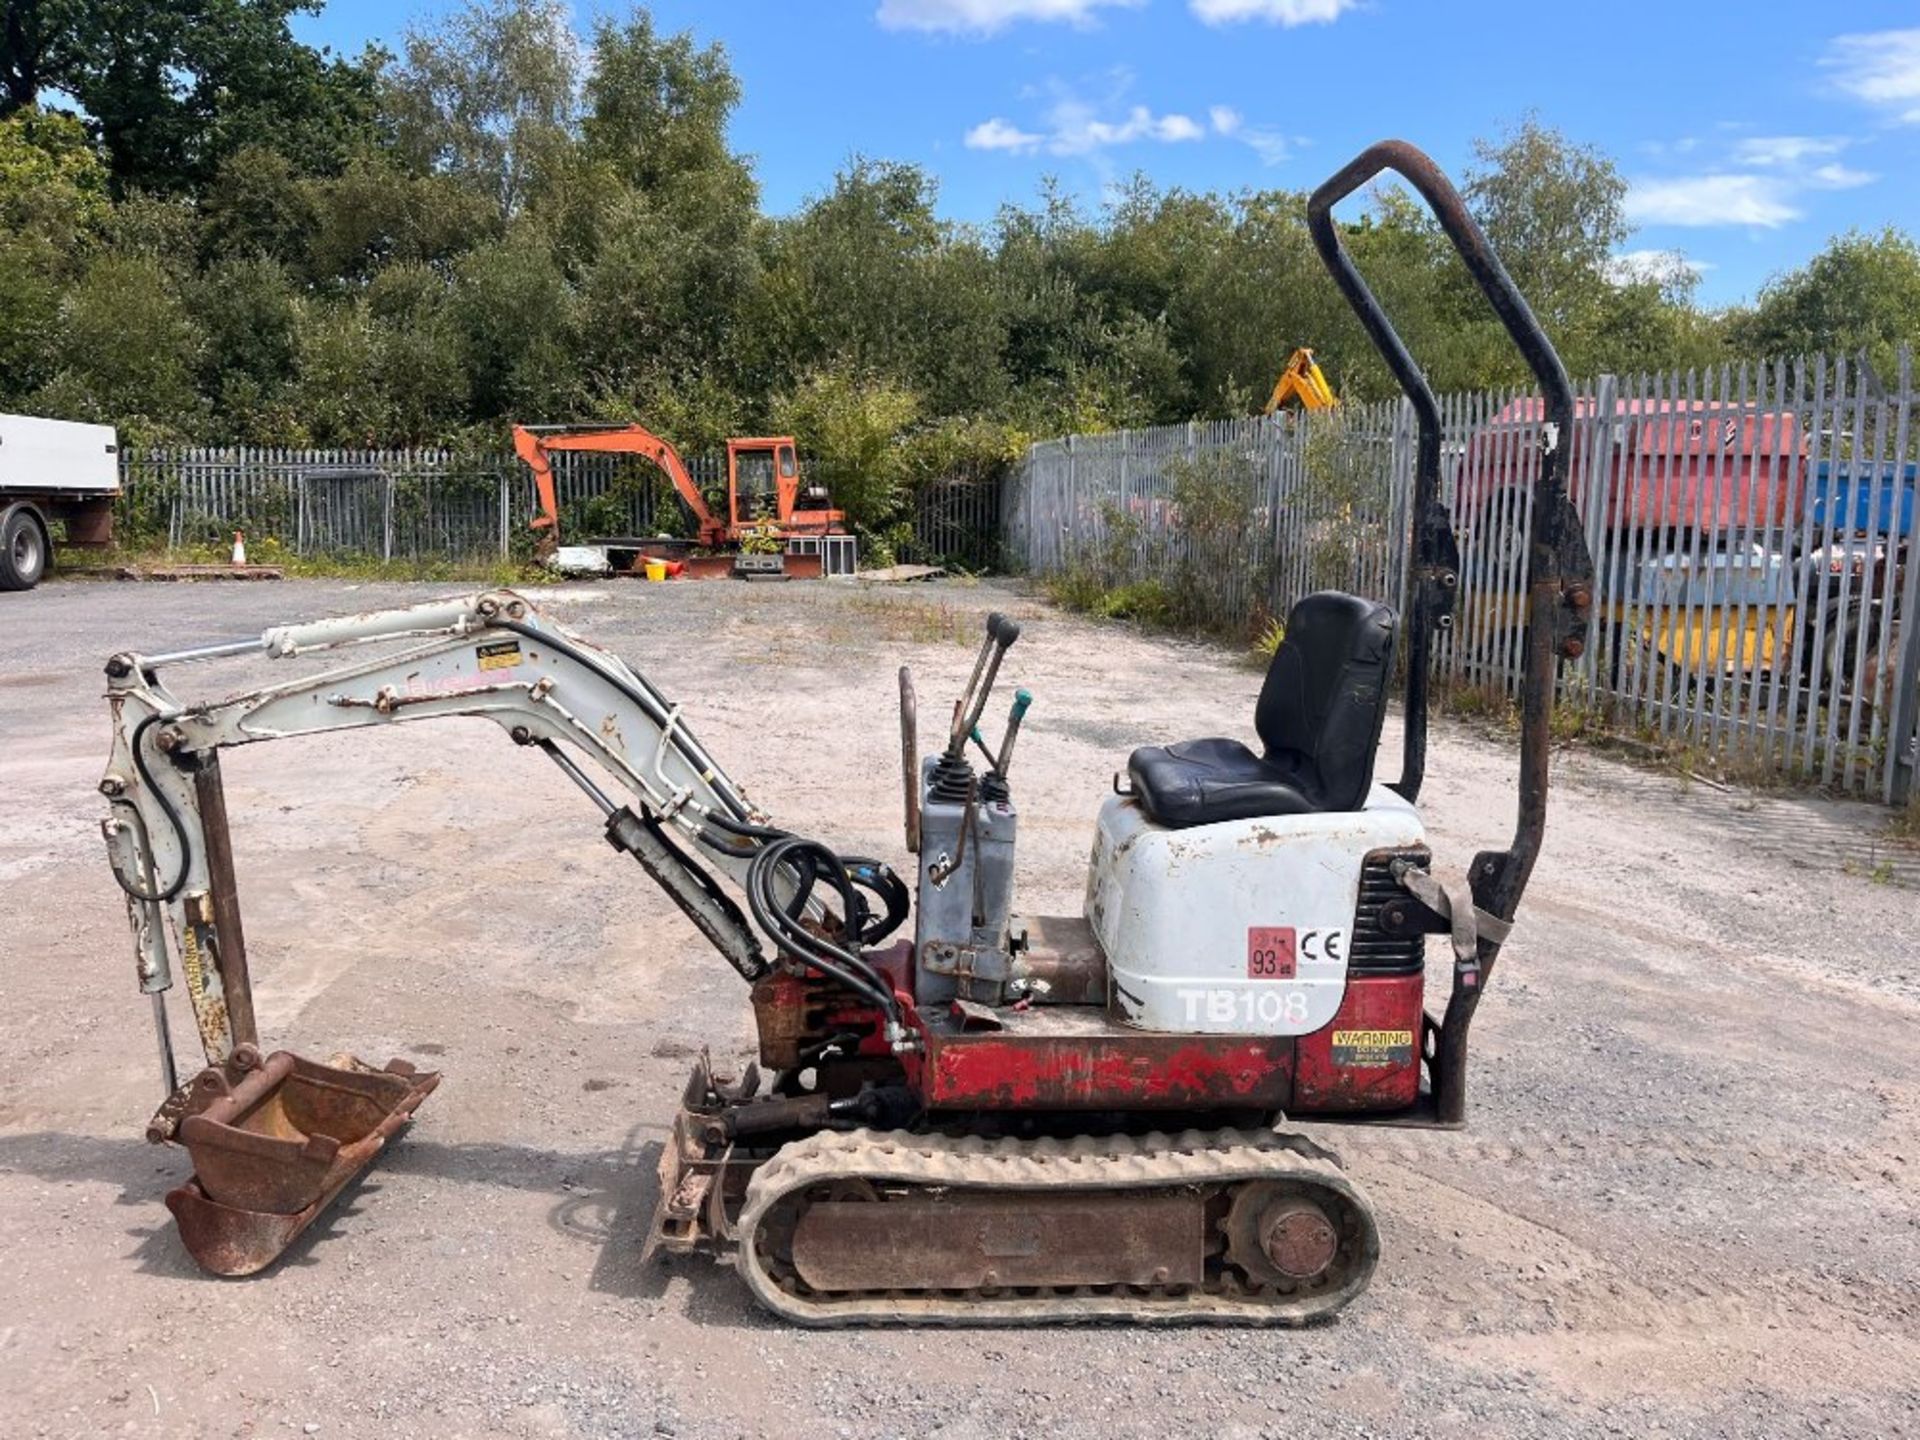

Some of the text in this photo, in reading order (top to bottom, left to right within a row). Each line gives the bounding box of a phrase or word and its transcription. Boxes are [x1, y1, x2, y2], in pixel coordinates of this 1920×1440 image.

[1301, 931, 1340, 960] CE
[1253, 949, 1276, 974] 93
[1177, 989, 1308, 1024] TB108
[1335, 1032, 1410, 1045] WARNING
